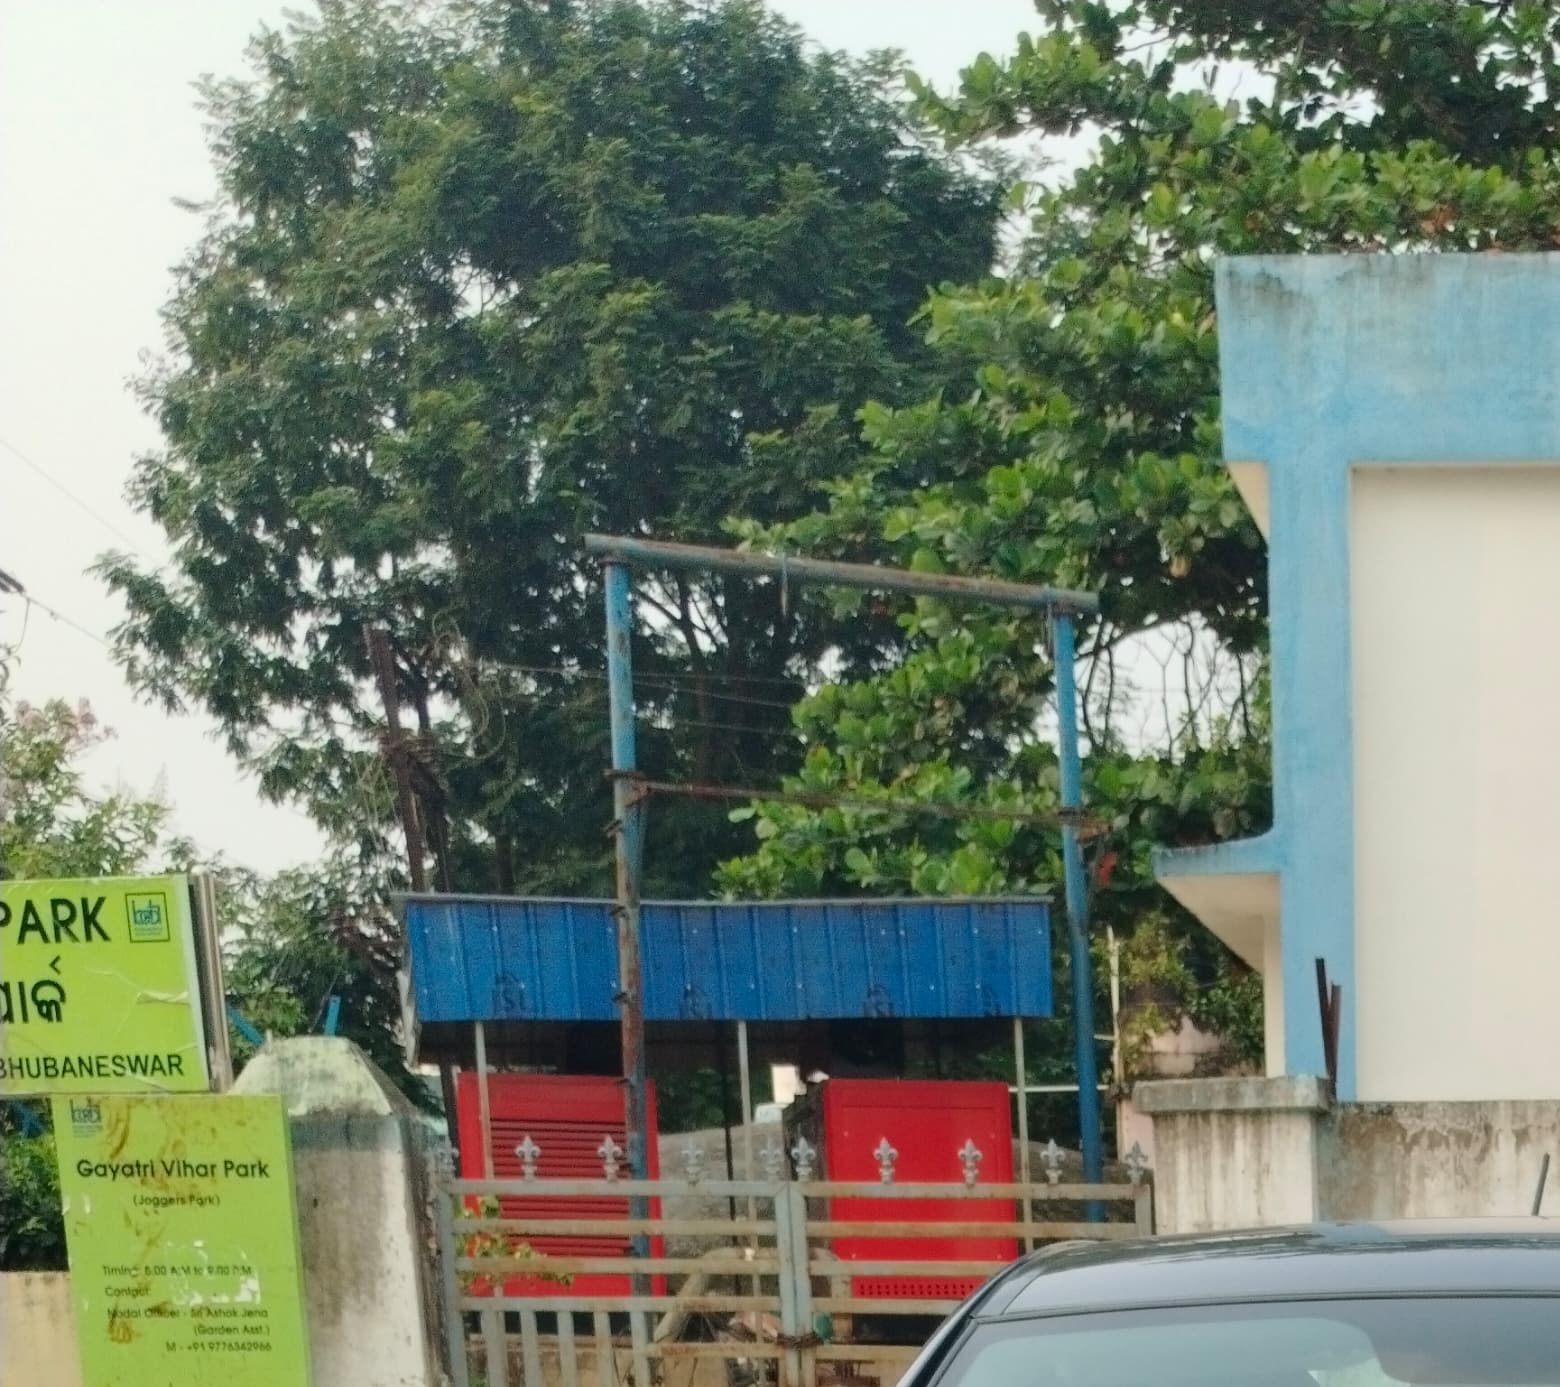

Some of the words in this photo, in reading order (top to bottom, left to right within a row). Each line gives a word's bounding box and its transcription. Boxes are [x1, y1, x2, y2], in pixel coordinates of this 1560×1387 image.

[76, 1158, 155, 1181] Gayatri
[160, 1159, 217, 1178] Vihar
[224, 1159, 270, 1178] Park
